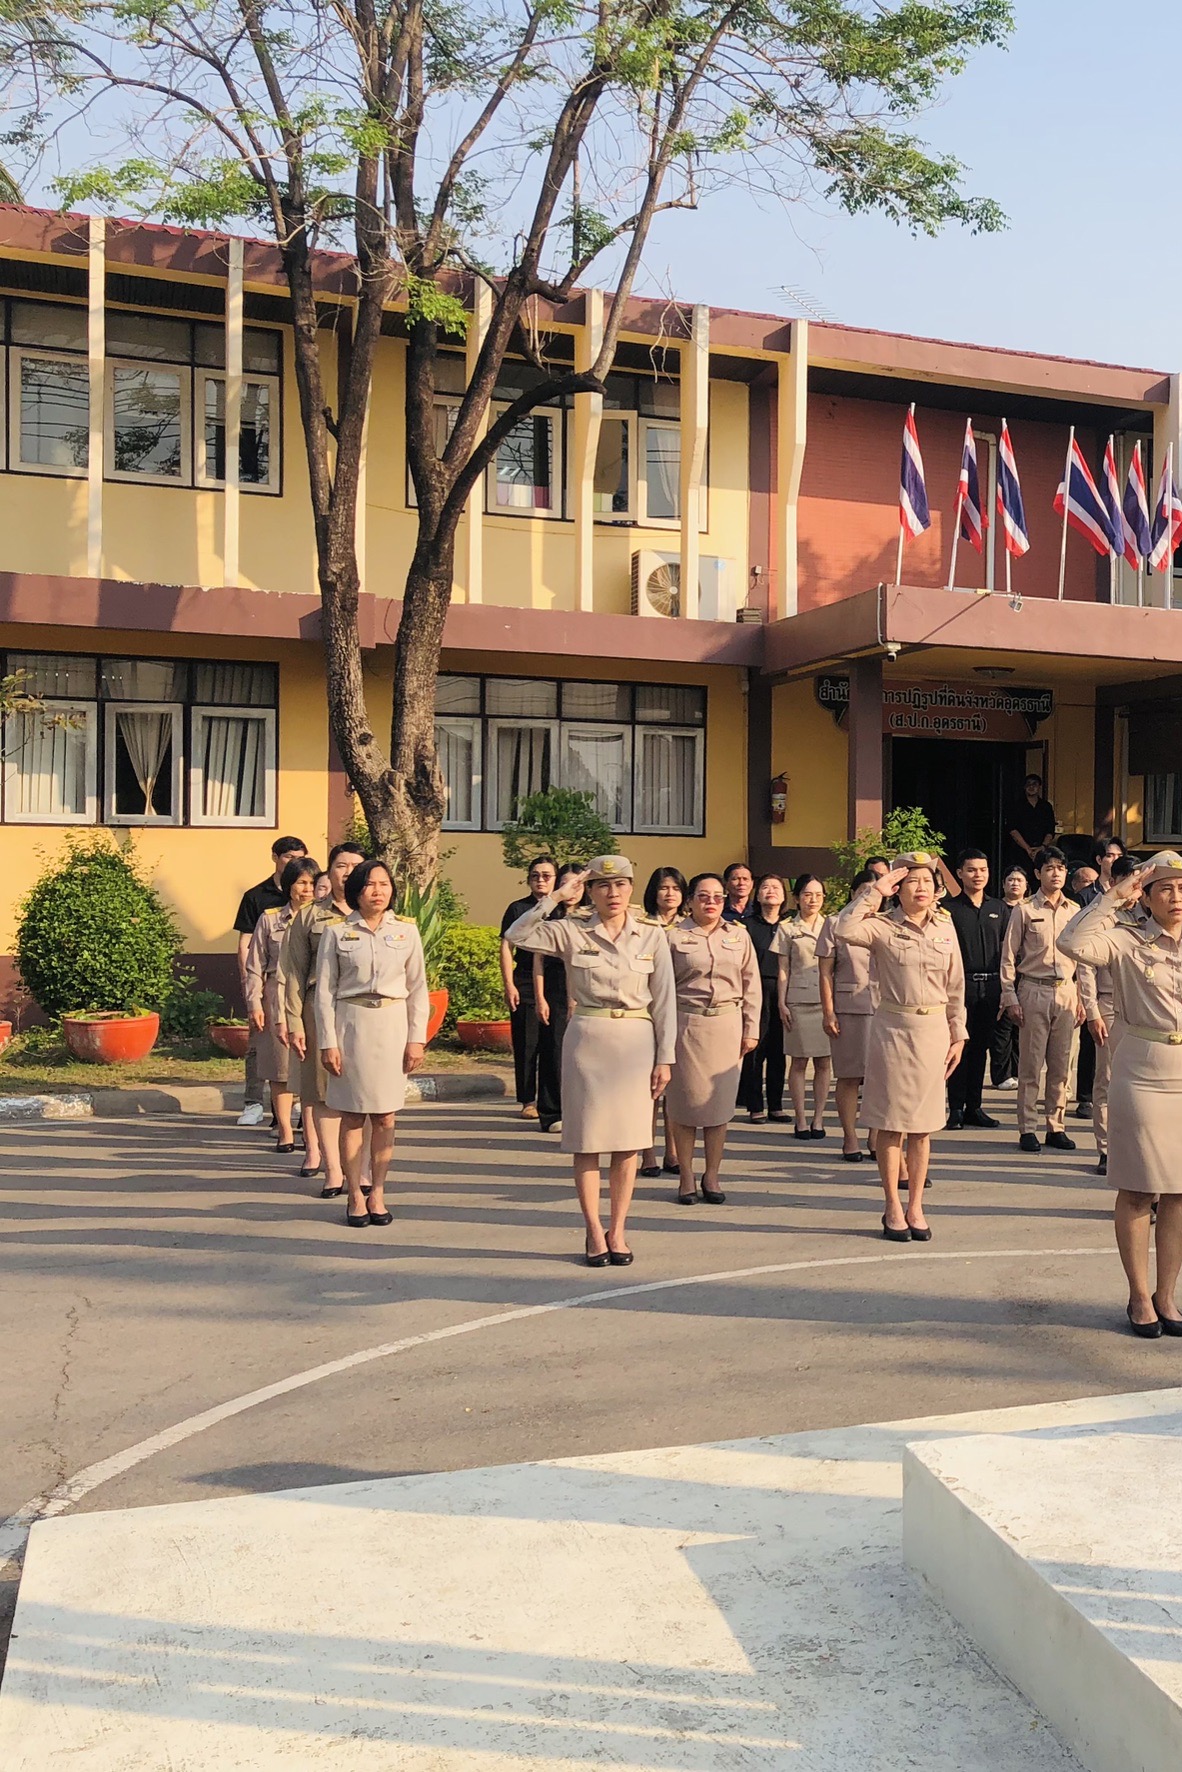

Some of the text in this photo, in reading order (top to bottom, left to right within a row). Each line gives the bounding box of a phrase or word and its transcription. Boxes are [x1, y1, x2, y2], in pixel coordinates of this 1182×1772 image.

[888, 711, 988, 735] (ส.ป.ก.อุดรธานี)
